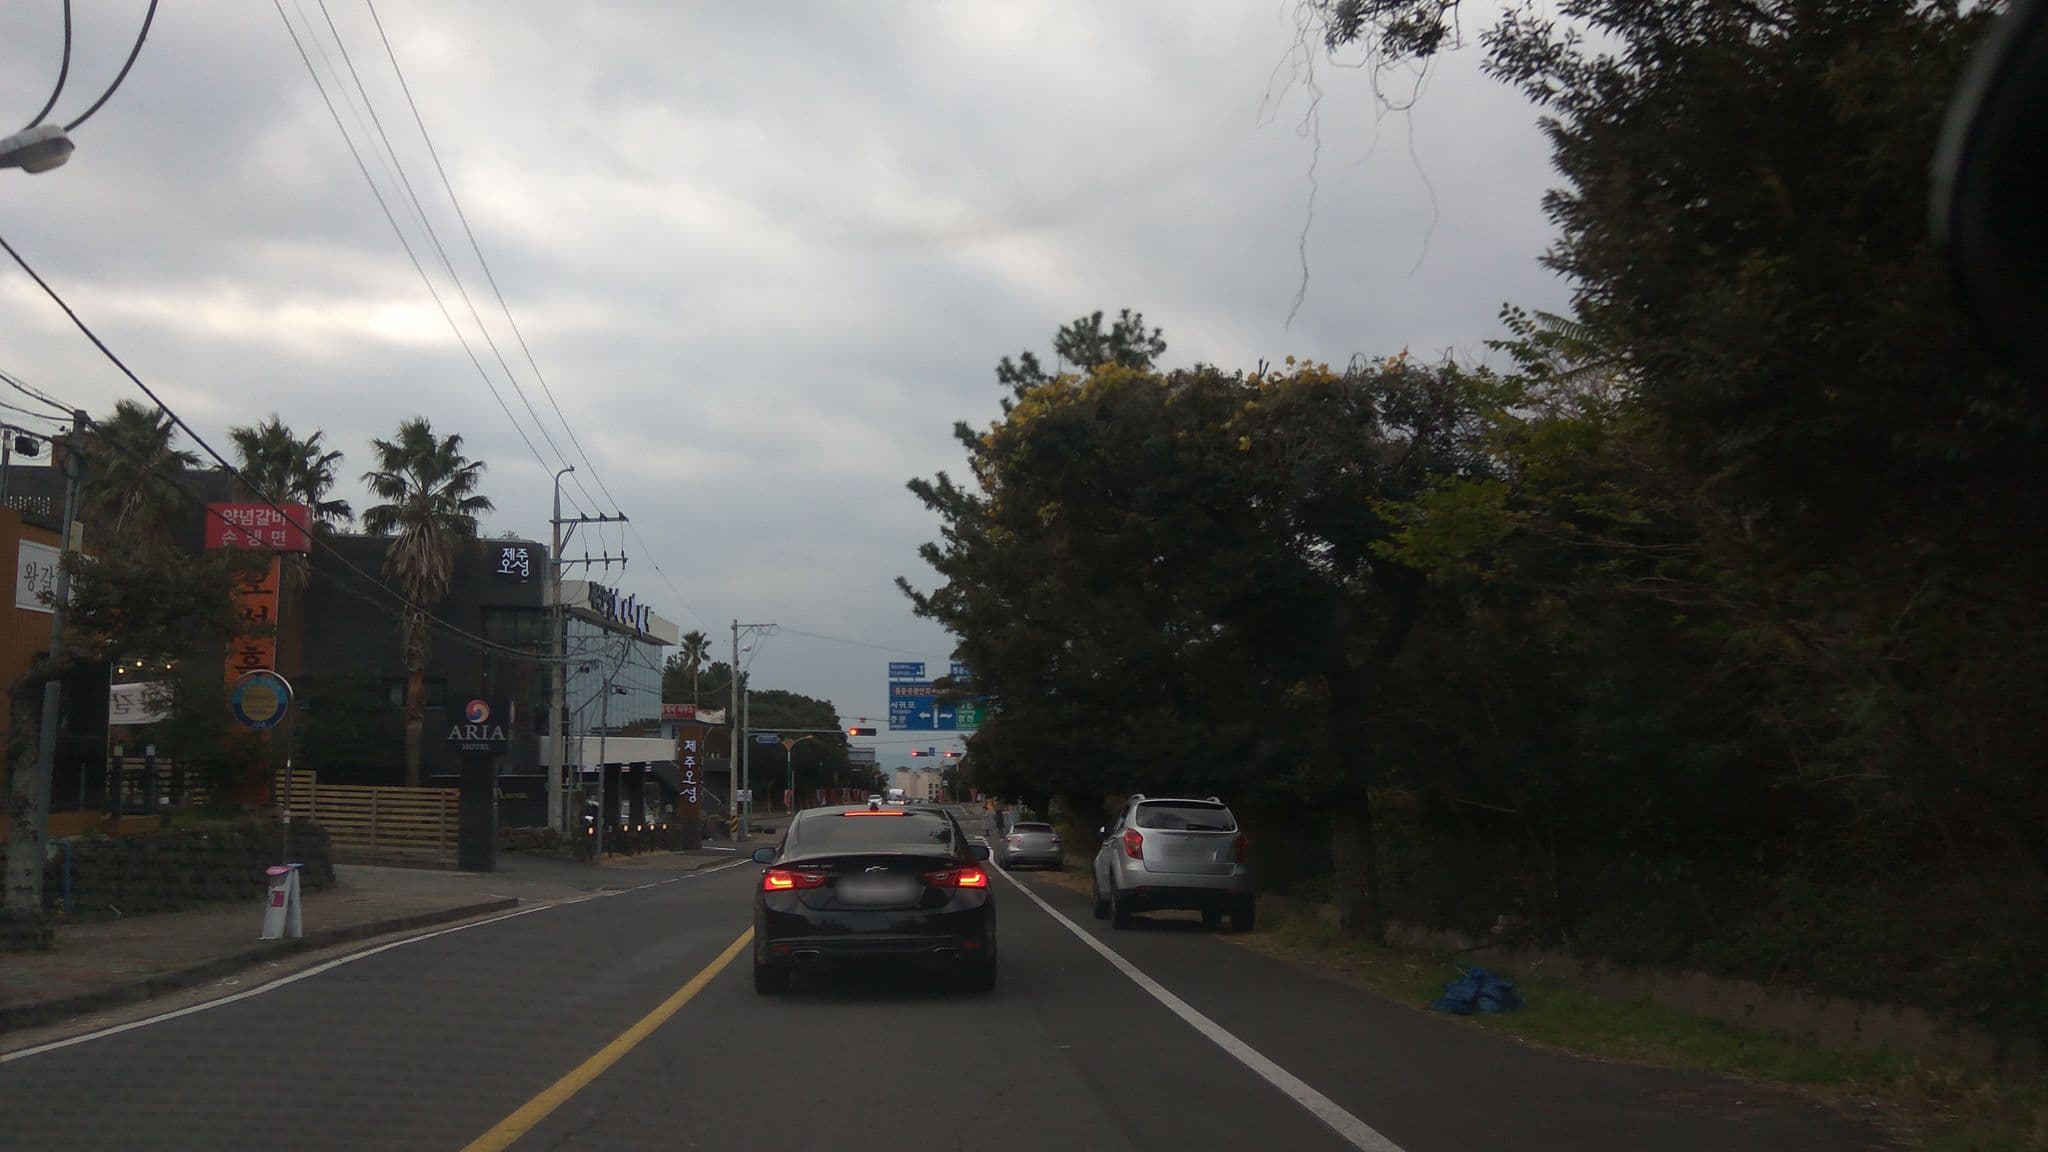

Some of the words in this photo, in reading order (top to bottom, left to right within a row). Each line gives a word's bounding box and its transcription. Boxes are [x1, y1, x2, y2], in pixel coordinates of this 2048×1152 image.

[222, 508, 286, 526] 양념갈비
[502, 547, 529, 561] 제주
[24, 561, 55, 592] 왕갈
[496, 559, 530, 577] 오성
[890, 701, 916, 709] 서귀포
[447, 724, 506, 741] ARIA
[462, 743, 489, 751] HOTEL
[680, 740, 697, 803] 제주오성
